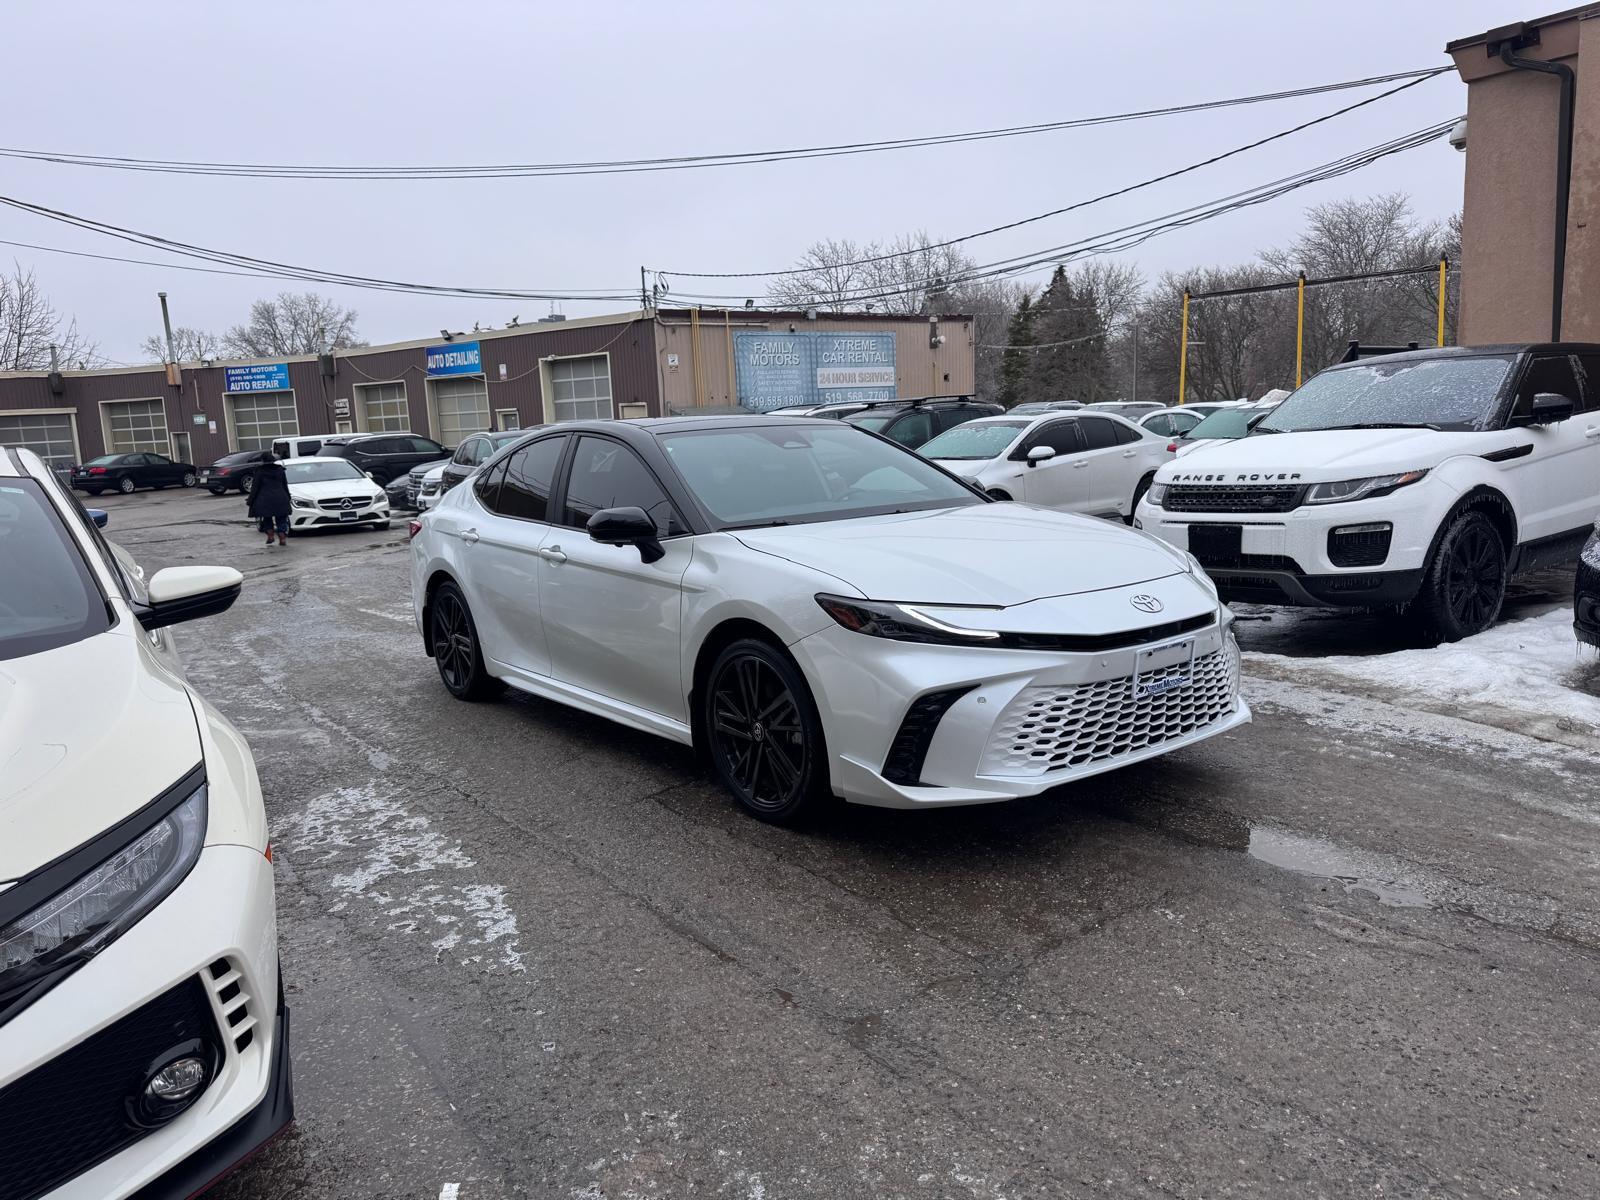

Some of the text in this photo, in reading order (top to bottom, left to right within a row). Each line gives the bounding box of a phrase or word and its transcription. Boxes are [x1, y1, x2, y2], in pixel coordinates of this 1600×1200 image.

[754, 342, 795, 354] FAMILY
[833, 340, 877, 351] XTREME
[428, 350, 479, 369] AUTO DETAILING
[751, 354, 800, 366] MOTORS
[823, 352, 889, 363] CAR RENTAL
[819, 371, 894, 384] 24 HOUR SERVICE
[230, 380, 279, 391] AUTO REPAIR
[1237, 473, 1301, 482] ROVER
